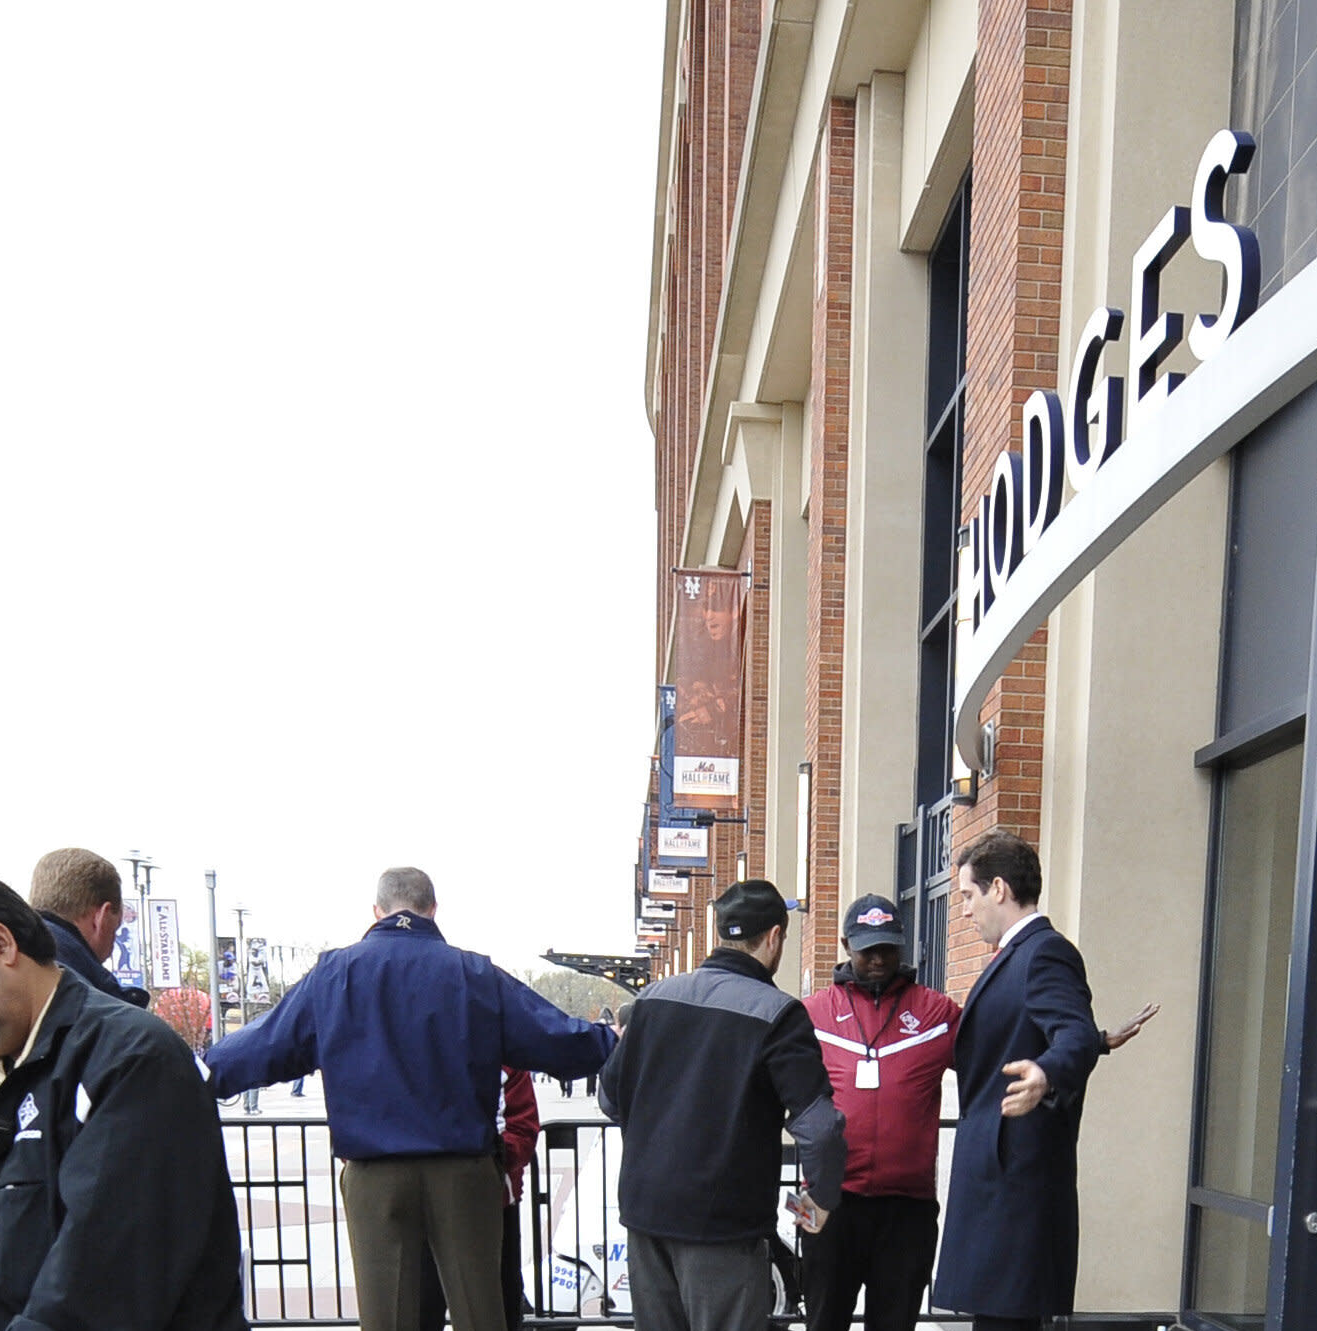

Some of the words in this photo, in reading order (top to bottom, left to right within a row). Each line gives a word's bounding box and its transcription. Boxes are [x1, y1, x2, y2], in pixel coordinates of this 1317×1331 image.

[968, 128, 1261, 637] HODGES
[682, 772, 701, 782] HALL
[708, 773, 731, 785] FAME
